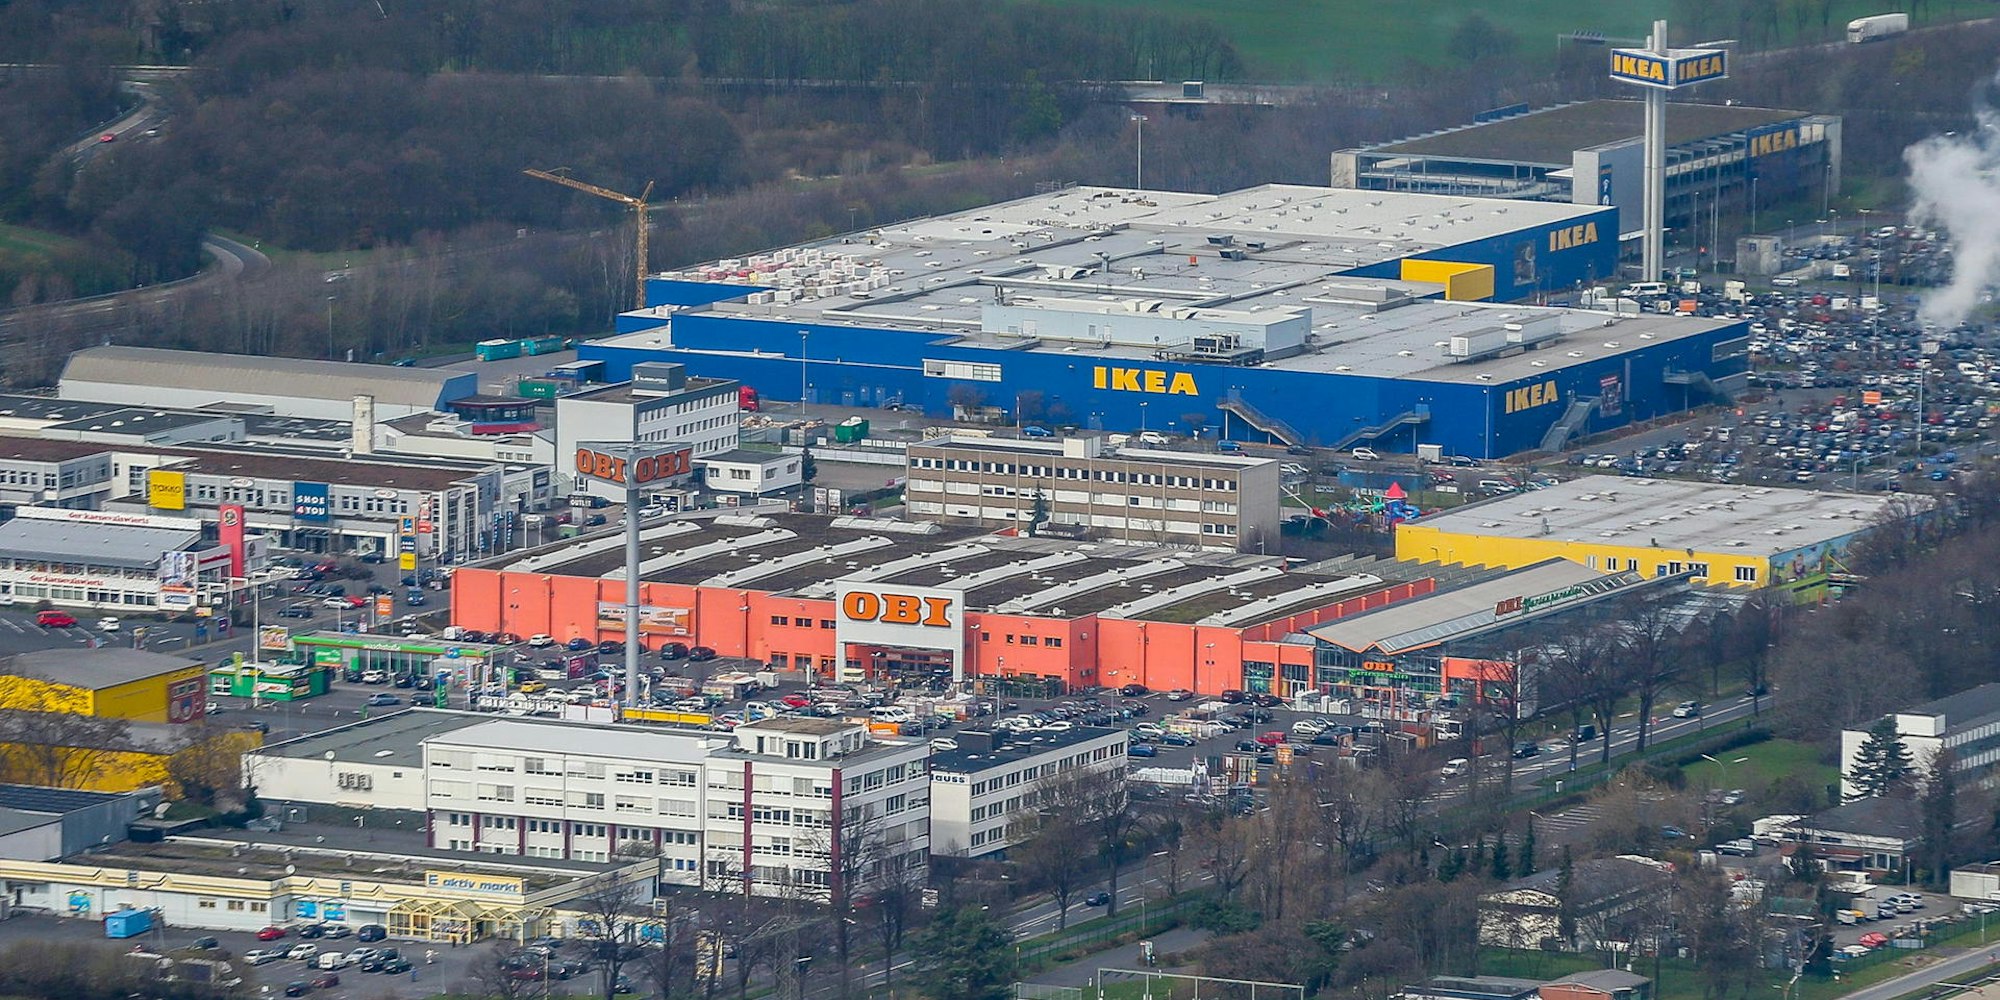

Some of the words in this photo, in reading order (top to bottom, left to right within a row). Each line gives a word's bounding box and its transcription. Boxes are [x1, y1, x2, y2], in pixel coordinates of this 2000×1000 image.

[1613, 54, 1665, 81] IKEA
[1679, 56, 1723, 80] IKEA
[1751, 128, 1796, 157] IKEA
[1549, 221, 1599, 252] IKEA
[1093, 366, 1200, 396] IKEA
[1505, 380, 1558, 414] IKEA
[576, 448, 627, 484] OBI
[634, 447, 692, 484] OBI
[296, 495, 325, 504] SHOE
[842, 591, 953, 628] OBI
[1495, 595, 1523, 616] OBI
[1363, 661, 1394, 672] OBI
[428, 874, 438, 885] E
[443, 878, 475, 889] aktiv
[480, 882, 519, 892] markt
